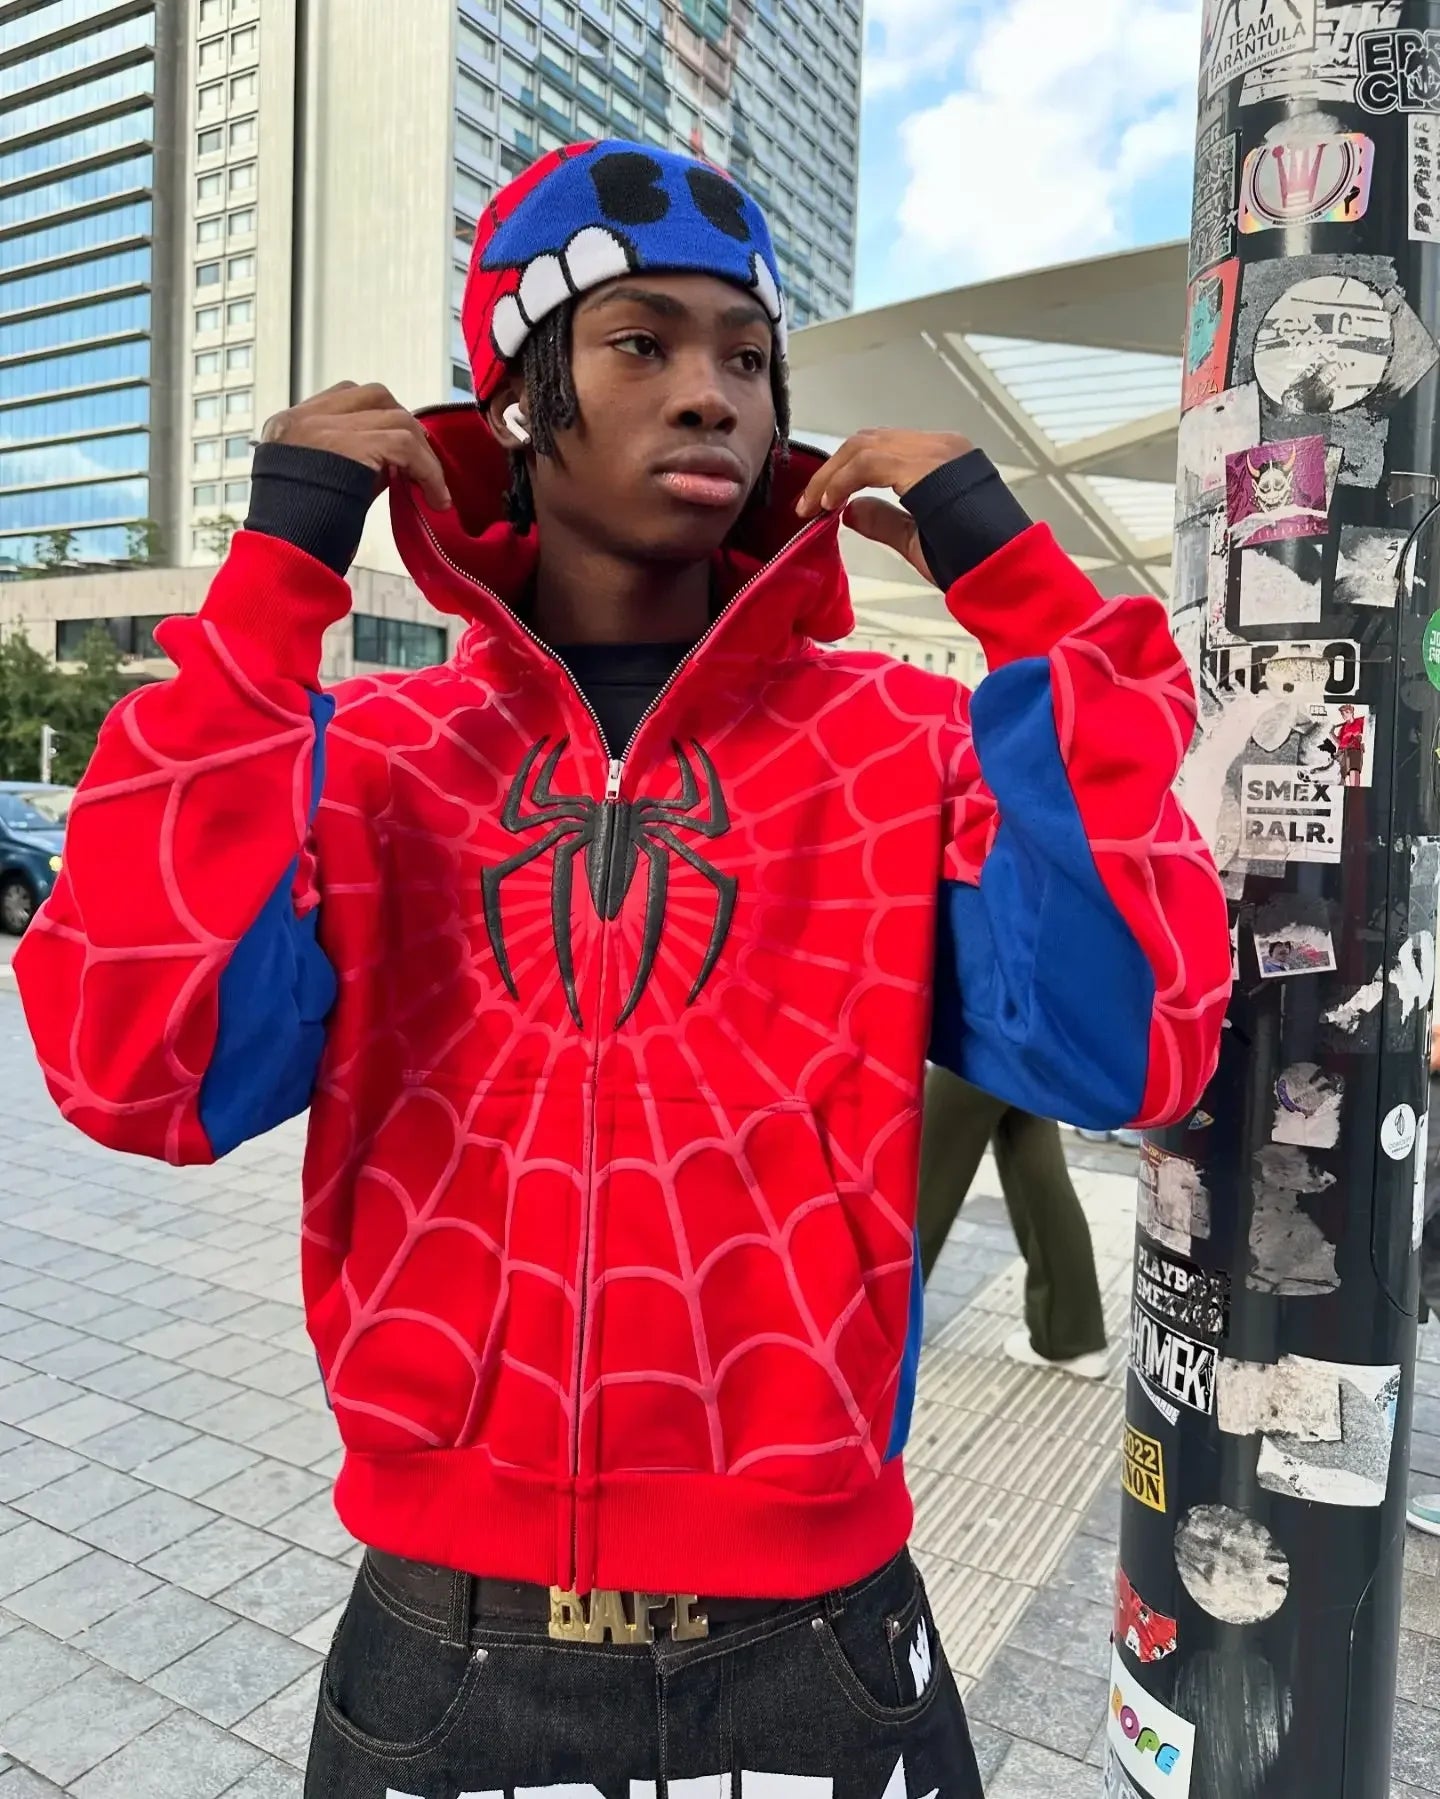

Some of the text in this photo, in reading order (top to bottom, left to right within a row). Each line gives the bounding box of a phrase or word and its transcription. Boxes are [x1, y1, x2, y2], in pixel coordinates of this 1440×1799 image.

[1228, 13, 1274, 50] TEAM
[1210, 21, 1307, 82] TARANTULA
[1247, 780, 1331, 802] SMEX
